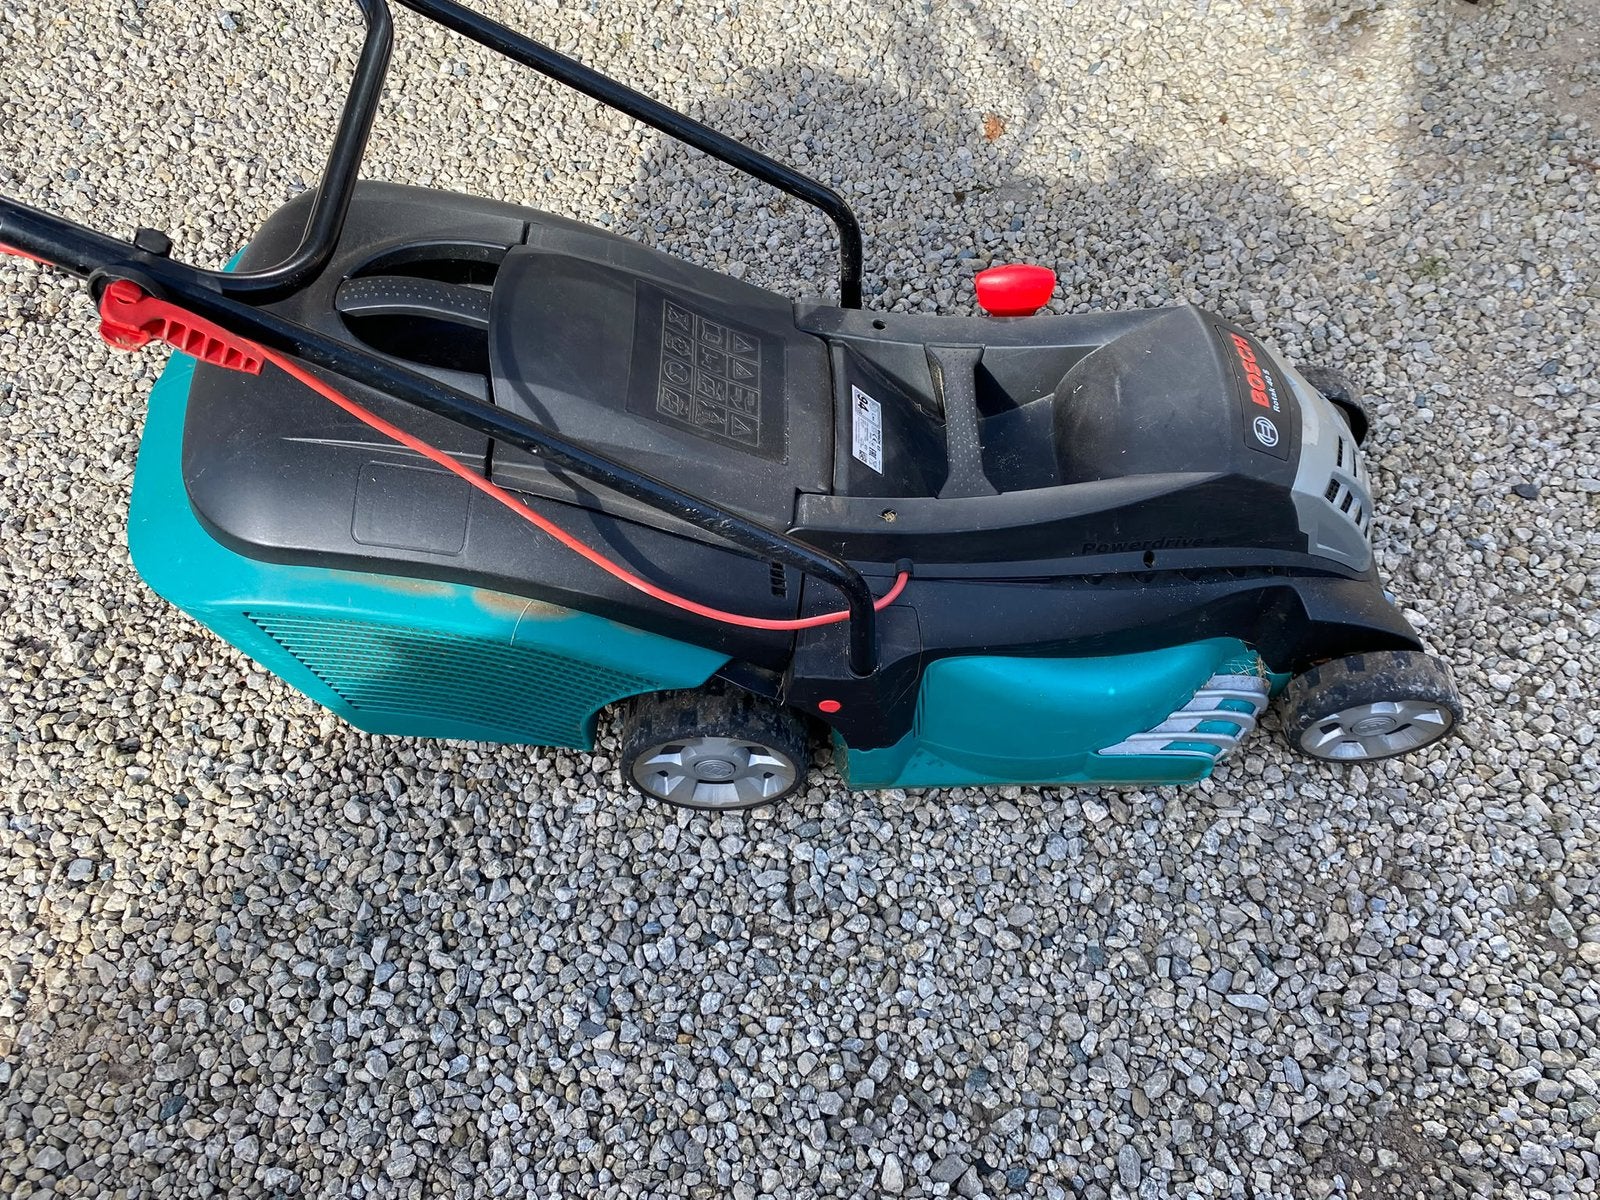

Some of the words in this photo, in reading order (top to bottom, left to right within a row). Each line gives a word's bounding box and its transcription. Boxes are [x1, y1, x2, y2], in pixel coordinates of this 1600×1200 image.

[1230, 333, 1270, 408] BOSCH
[1264, 375, 1275, 388] 40
[857, 394, 869, 412] 94
[1268, 387, 1281, 412] Rotak
[1082, 537, 1204, 554] Powerdrive
